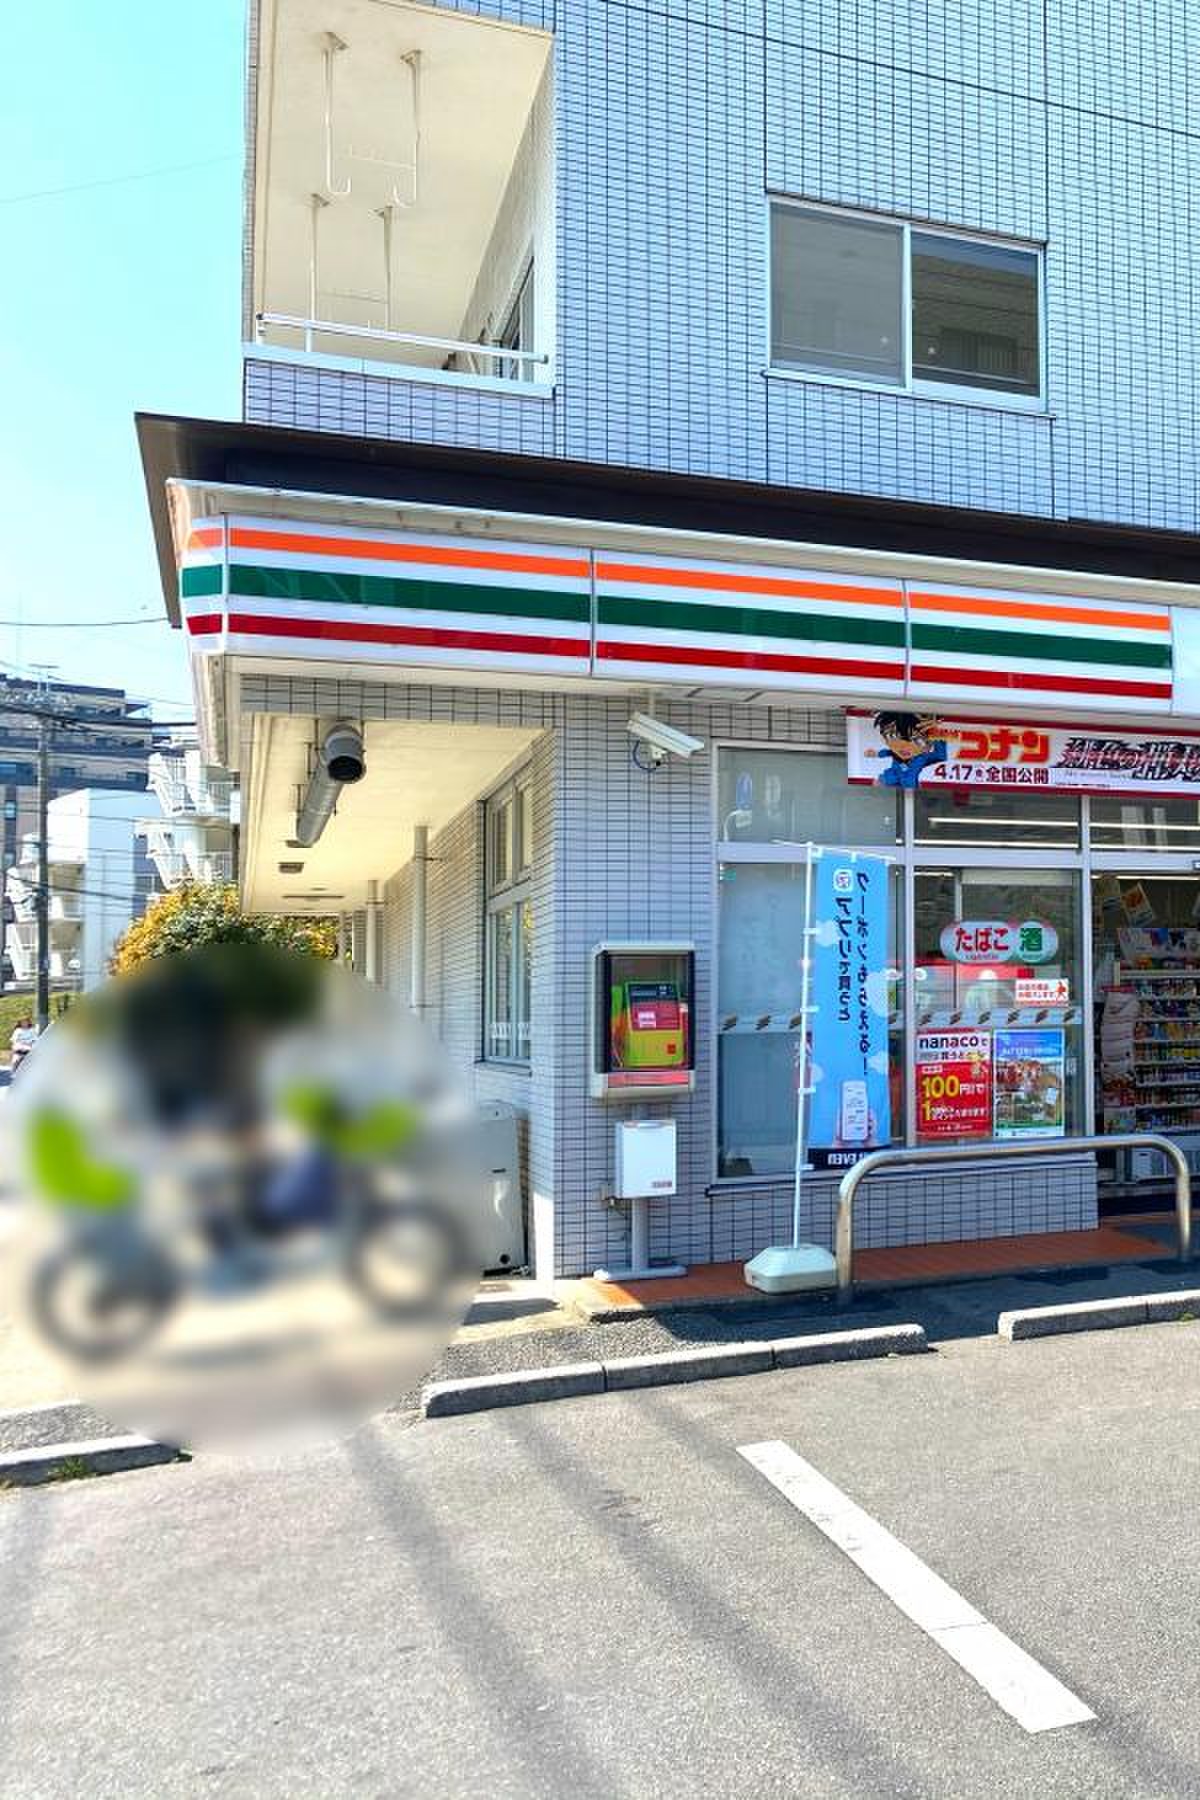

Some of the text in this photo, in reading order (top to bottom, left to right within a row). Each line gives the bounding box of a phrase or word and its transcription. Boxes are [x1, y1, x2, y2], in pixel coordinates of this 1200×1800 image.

[955, 927, 1043, 952] たばこ 酒
